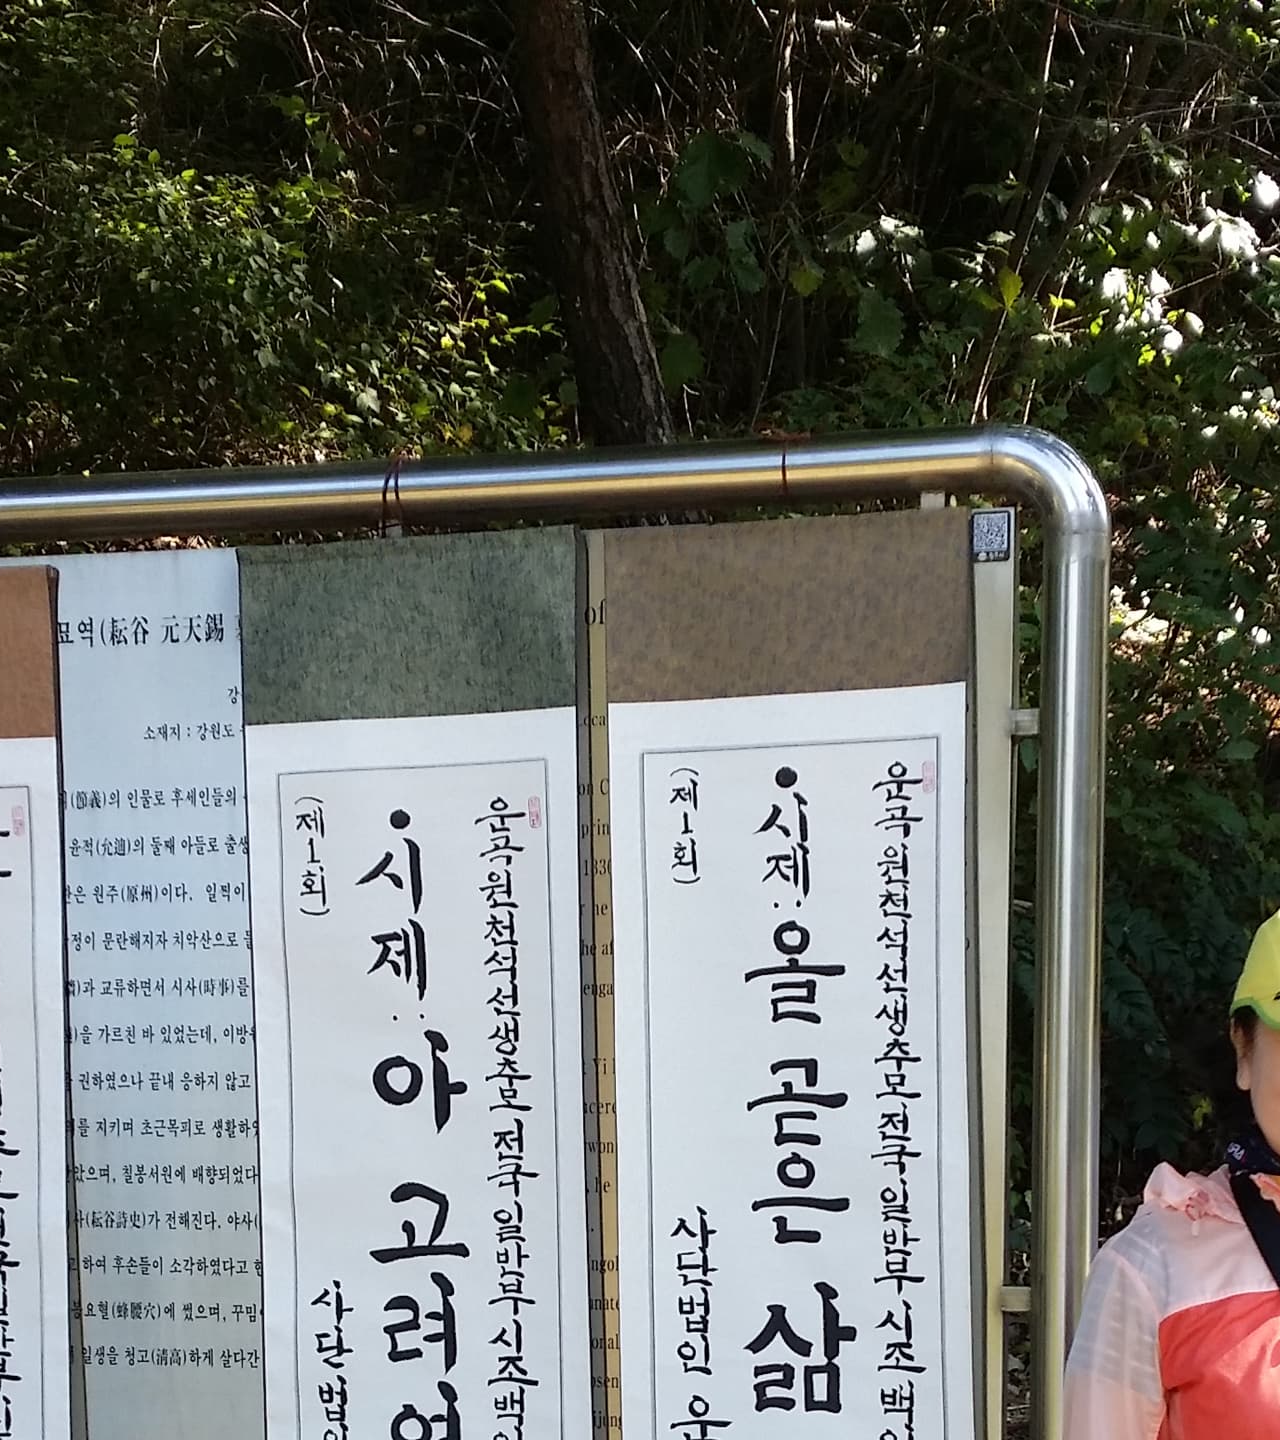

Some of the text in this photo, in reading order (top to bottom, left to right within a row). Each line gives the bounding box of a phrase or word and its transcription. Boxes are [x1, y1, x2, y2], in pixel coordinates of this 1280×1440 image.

[144, 723, 181, 740] 소재지
[196, 721, 235, 740] 강원도
[127, 788, 166, 808] 인물로
[171, 786, 236, 808] 후세인들의
[181, 835, 219, 856] 아들로
[103, 931, 167, 951] 문란해지자
[173, 930, 238, 950] 치악산으로
[100, 978, 164, 997] 교류하면서
[98, 1025, 135, 1044] 가르친
[142, 1024, 154, 1043] 바
[160, 1024, 217, 1044] 있었는데,
[79, 1072, 144, 1091] 권하였으나
[149, 1072, 175, 1091] 끝내
[180, 1072, 219, 1091] 응하지
[225, 1073, 251, 1091] 않고
[372, 1029, 468, 1134] 아
[96, 1118, 133, 1137] 지키며
[141, 1118, 206, 1138] 초근목피로
[122, 1164, 186, 1184] 칠봉서원에
[192, 1164, 259, 1185] 배향되었다
[165, 1211, 221, 1230] 전해진다.
[82, 1255, 106, 1275] 하여
[112, 1255, 163, 1276] 후손들이
[170, 1256, 249, 1277] 소각하였다고
[182, 1303, 226, 1323] 썼으며,
[744, 1281, 857, 1413] 삶
[220, 1349, 261, 1369] 살다간
